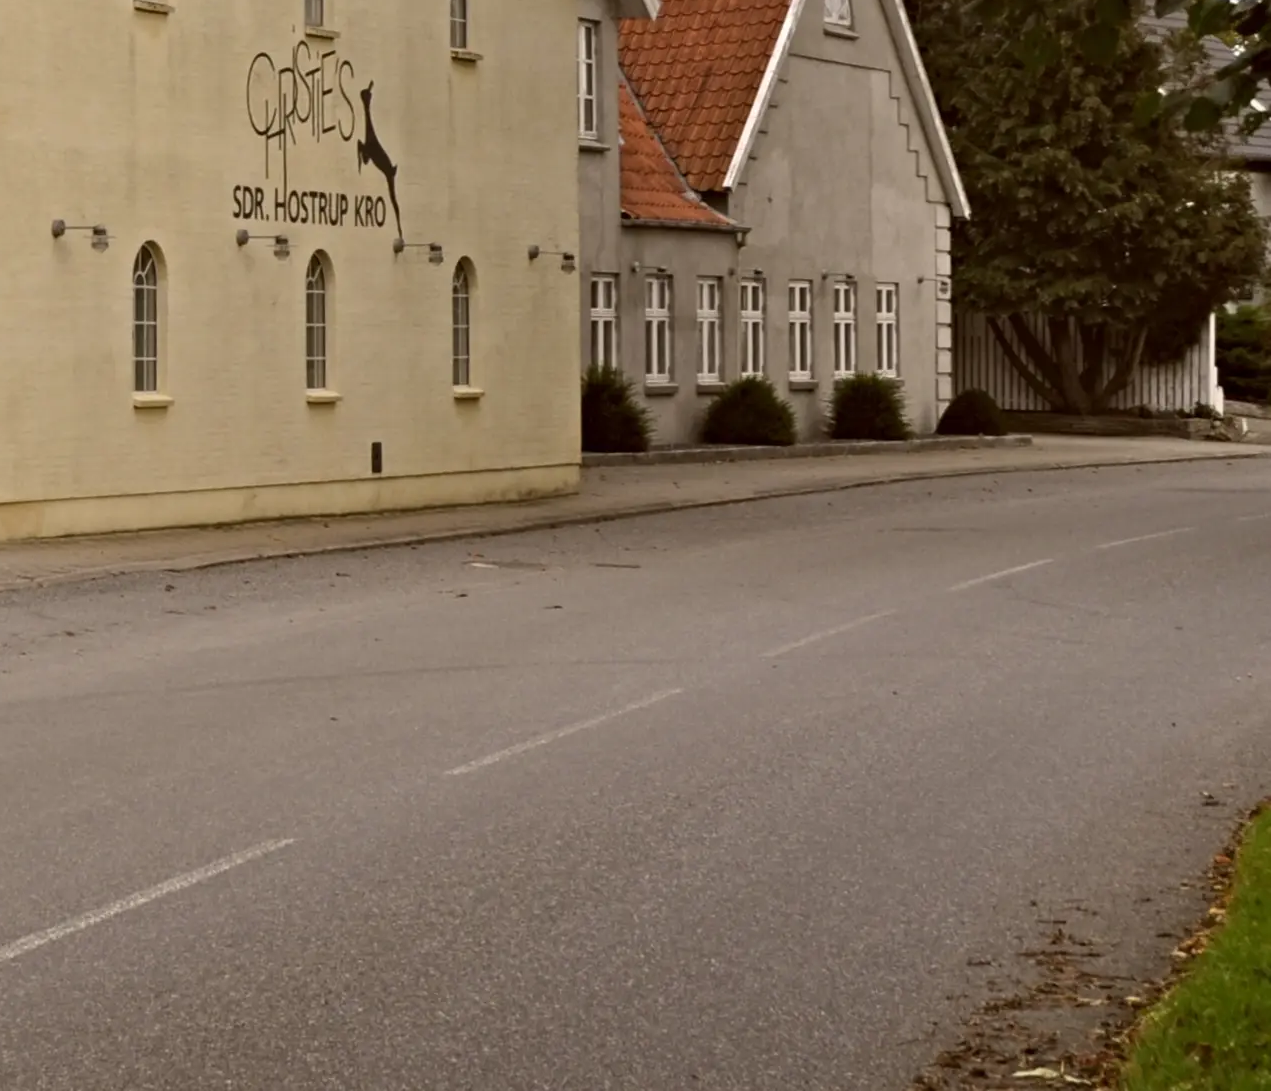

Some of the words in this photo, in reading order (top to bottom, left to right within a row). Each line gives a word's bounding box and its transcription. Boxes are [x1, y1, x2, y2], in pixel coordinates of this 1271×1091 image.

[233, 185, 270, 221] SDR.
[274, 186, 349, 227] HOSTRUP
[354, 194, 387, 228] KRO
